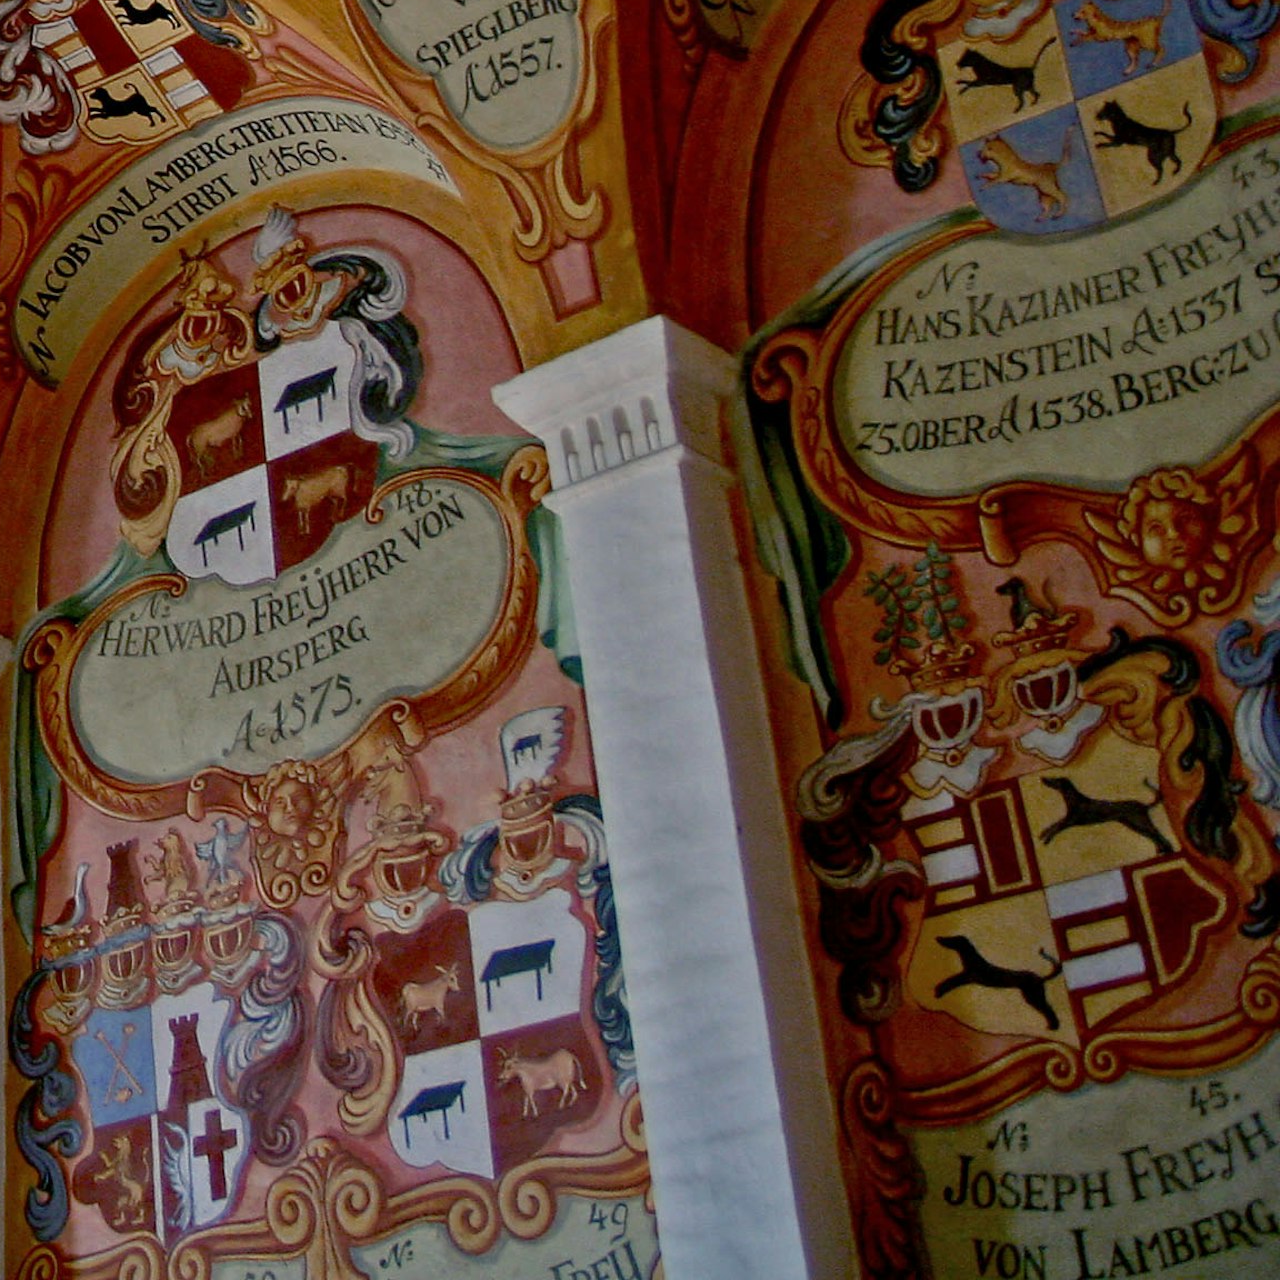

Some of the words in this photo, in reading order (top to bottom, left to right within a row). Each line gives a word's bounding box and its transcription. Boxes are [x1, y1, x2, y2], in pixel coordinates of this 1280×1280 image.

[86, 195, 142, 247] VON
[142, 173, 239, 243] STIRBT
[875, 306, 962, 346] HANS
[967, 266, 1146, 337] KAZIANER
[883, 326, 1114, 403] KAZENSTEIN
[98, 611, 246, 658] HERWARD
[401, 494, 465, 551] VON
[209, 615, 370, 698] AURSPERG
[943, 1154, 1115, 1213] JOSEPH
